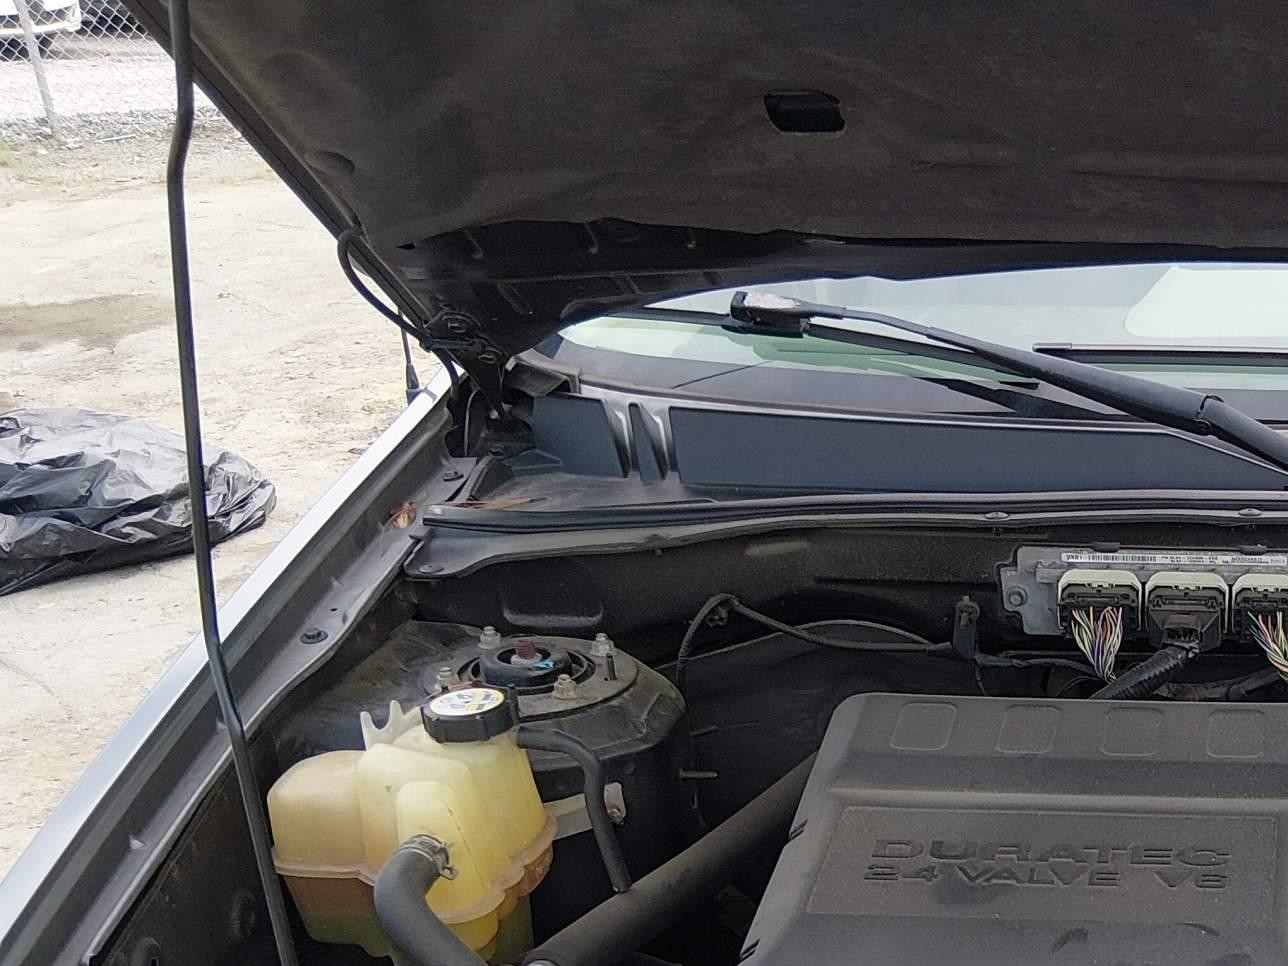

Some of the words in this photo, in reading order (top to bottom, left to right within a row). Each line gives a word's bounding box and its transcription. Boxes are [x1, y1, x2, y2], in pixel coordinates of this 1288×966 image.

[871, 839, 1231, 867] DURATEC
[863, 863, 939, 883] 24
[957, 865, 1121, 887] VALVE
[1153, 869, 1228, 889] V6
